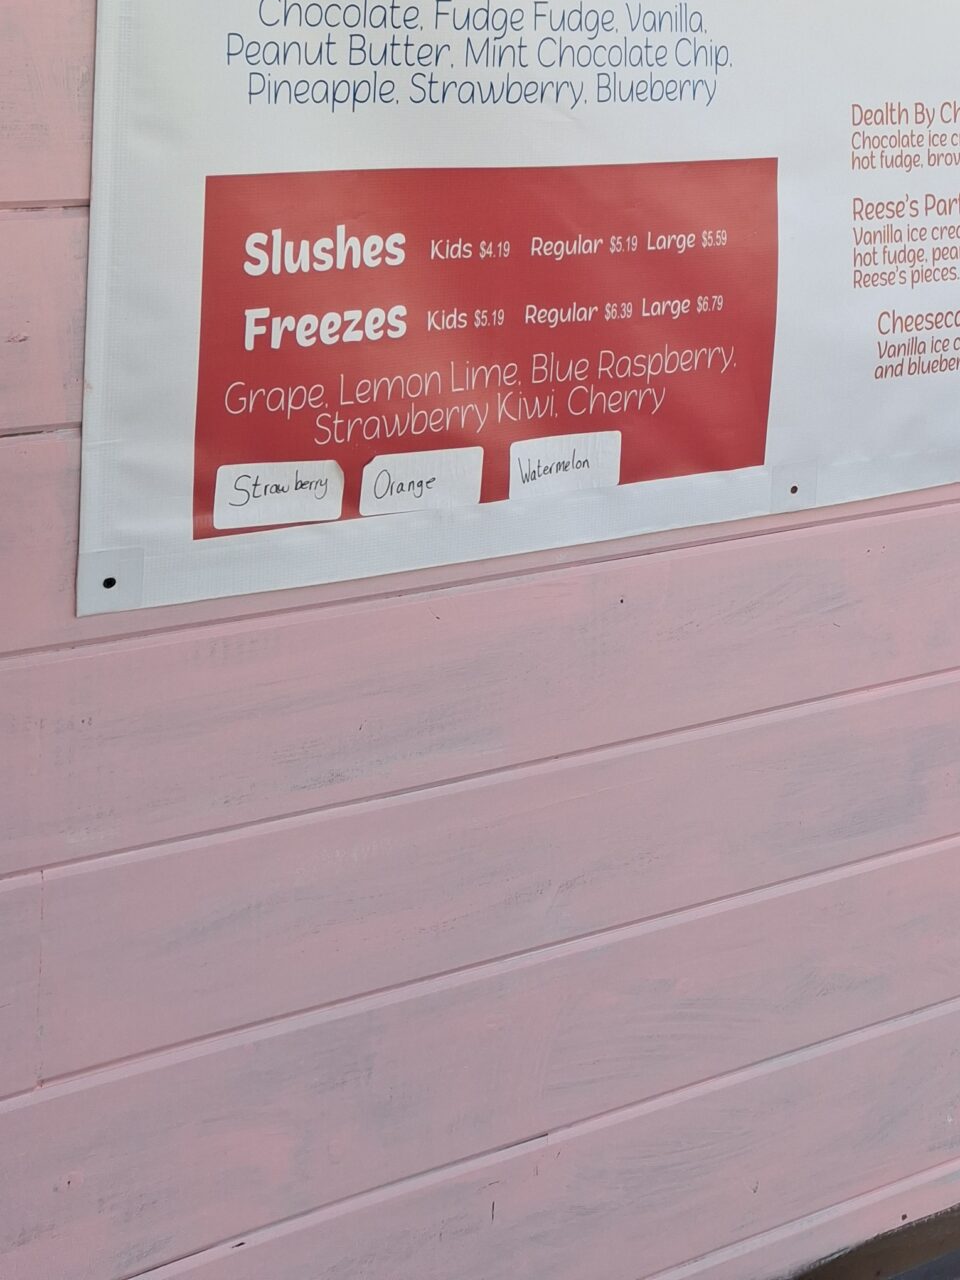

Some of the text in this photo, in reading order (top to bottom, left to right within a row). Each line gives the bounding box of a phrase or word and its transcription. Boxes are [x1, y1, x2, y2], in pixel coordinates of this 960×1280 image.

[434, 0, 525, 40] Fudge
[533, 1, 618, 40] Fudge,
[626, 2, 707, 34] Vanilla,
[226, 32, 337, 67] Peanut
[349, 34, 454, 69] Butter,
[465, 34, 528, 68] Mint
[537, 35, 668, 68] Chocolate
[248, 71, 717, 112] Pineapple, Strawberry, Blueberry
[852, 102, 908, 126] Dealth
[914, 102, 935, 128] By
[851, 130, 947, 150] Chocolate ice
[852, 151, 876, 170] hot
[853, 195, 919, 221] Reese's
[853, 224, 927, 245] Vanilla ice
[243, 224, 727, 277] Slushes Kids $4.19 Regular $5.19 Large $5.59
[853, 247, 878, 267] hot
[853, 266, 907, 288] Reese's
[243, 295, 723, 351] Freezes Kids $5.19 Regular $6.39 Large $6.79
[877, 337, 926, 359] Vanilla
[931, 335, 949, 353] ice
[874, 358, 903, 380] and
[225, 381, 328, 419] Grape,
[340, 370, 441, 406] Lemon
[532, 352, 589, 384] Blue
[315, 403, 488, 445] Strawberry
[568, 384, 666, 416] Cherry
[518, 448, 590, 485] Watermelon
[374, 469, 436, 504] Orange
